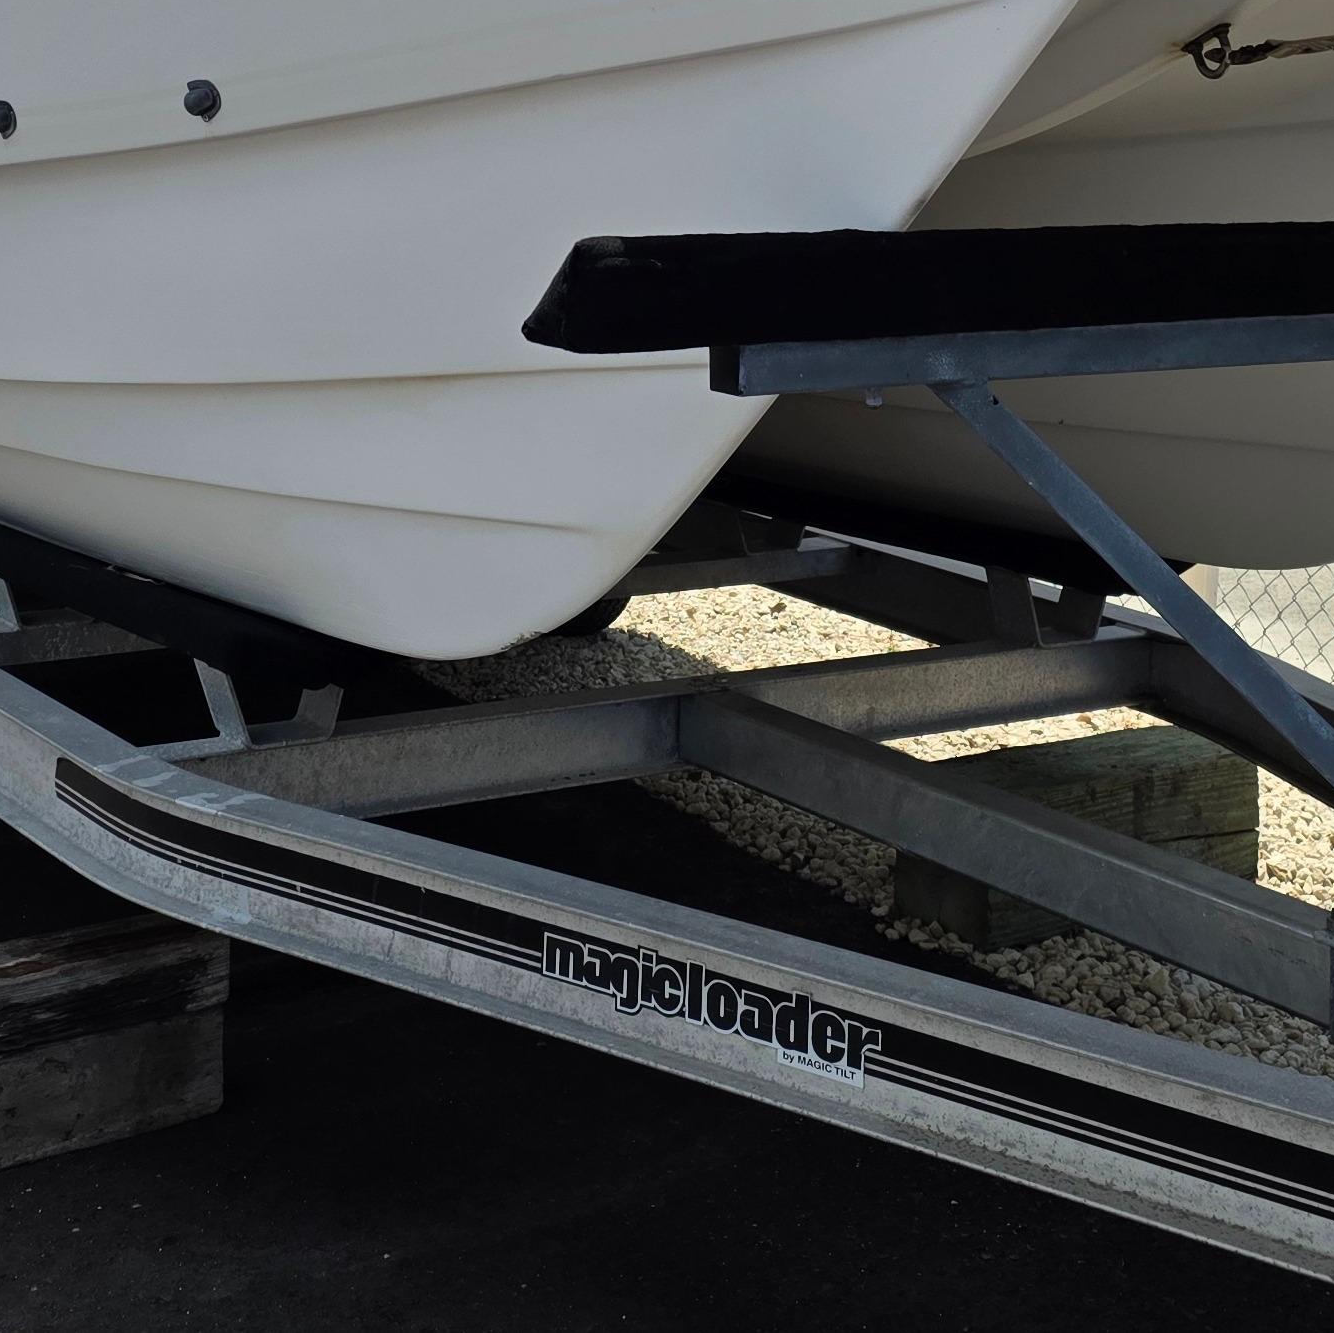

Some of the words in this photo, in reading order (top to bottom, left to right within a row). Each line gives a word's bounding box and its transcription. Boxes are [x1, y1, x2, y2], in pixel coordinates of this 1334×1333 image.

[782, 1051, 795, 1063] by
[797, 1055, 833, 1073] MAGIC
[834, 1066, 857, 1081] TILT
